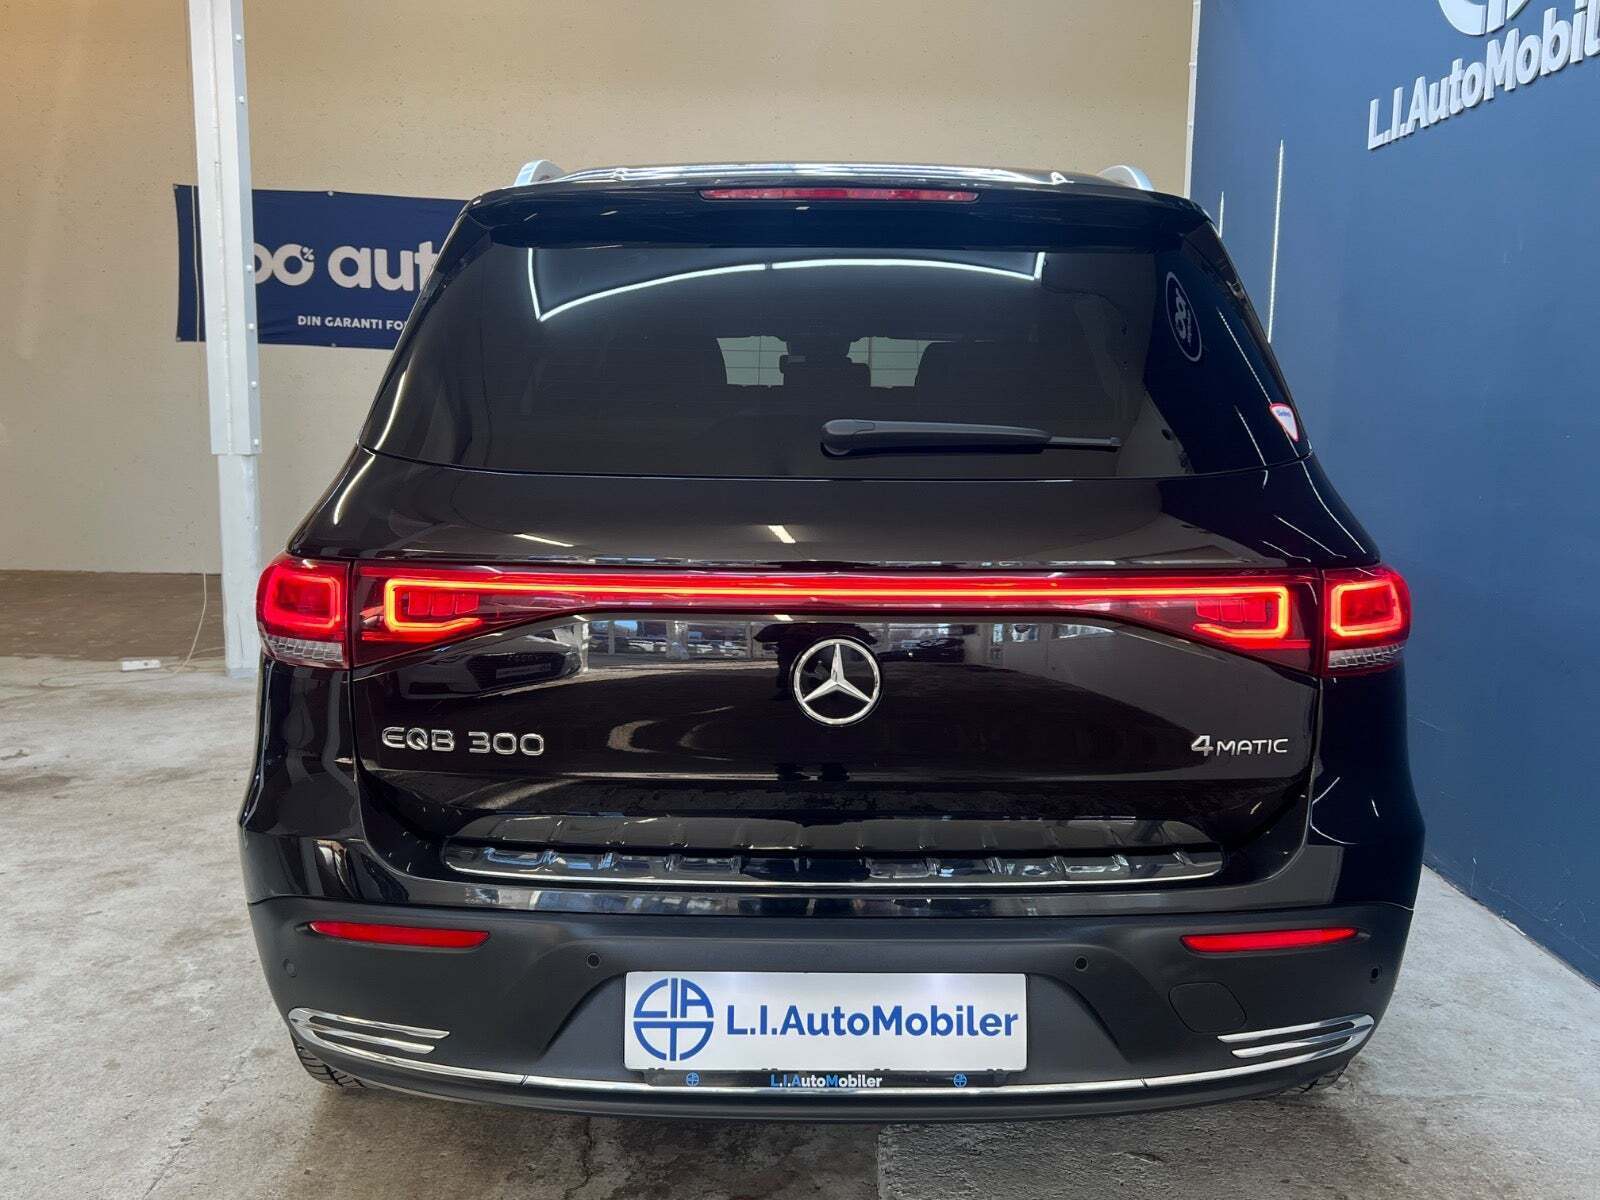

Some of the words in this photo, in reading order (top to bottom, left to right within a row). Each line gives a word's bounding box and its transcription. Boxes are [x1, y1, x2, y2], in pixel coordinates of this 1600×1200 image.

[297, 315, 321, 327] DIN
[325, 317, 382, 330] GARANTI
[386, 320, 408, 331] FO
[382, 726, 455, 752] EQB
[468, 731, 545, 756] 300
[1191, 735, 1289, 757] 4MATIC
[726, 1004, 1019, 1036] L.I.AutoMobiler
[770, 1074, 883, 1088] L.I.AutoMobiler
